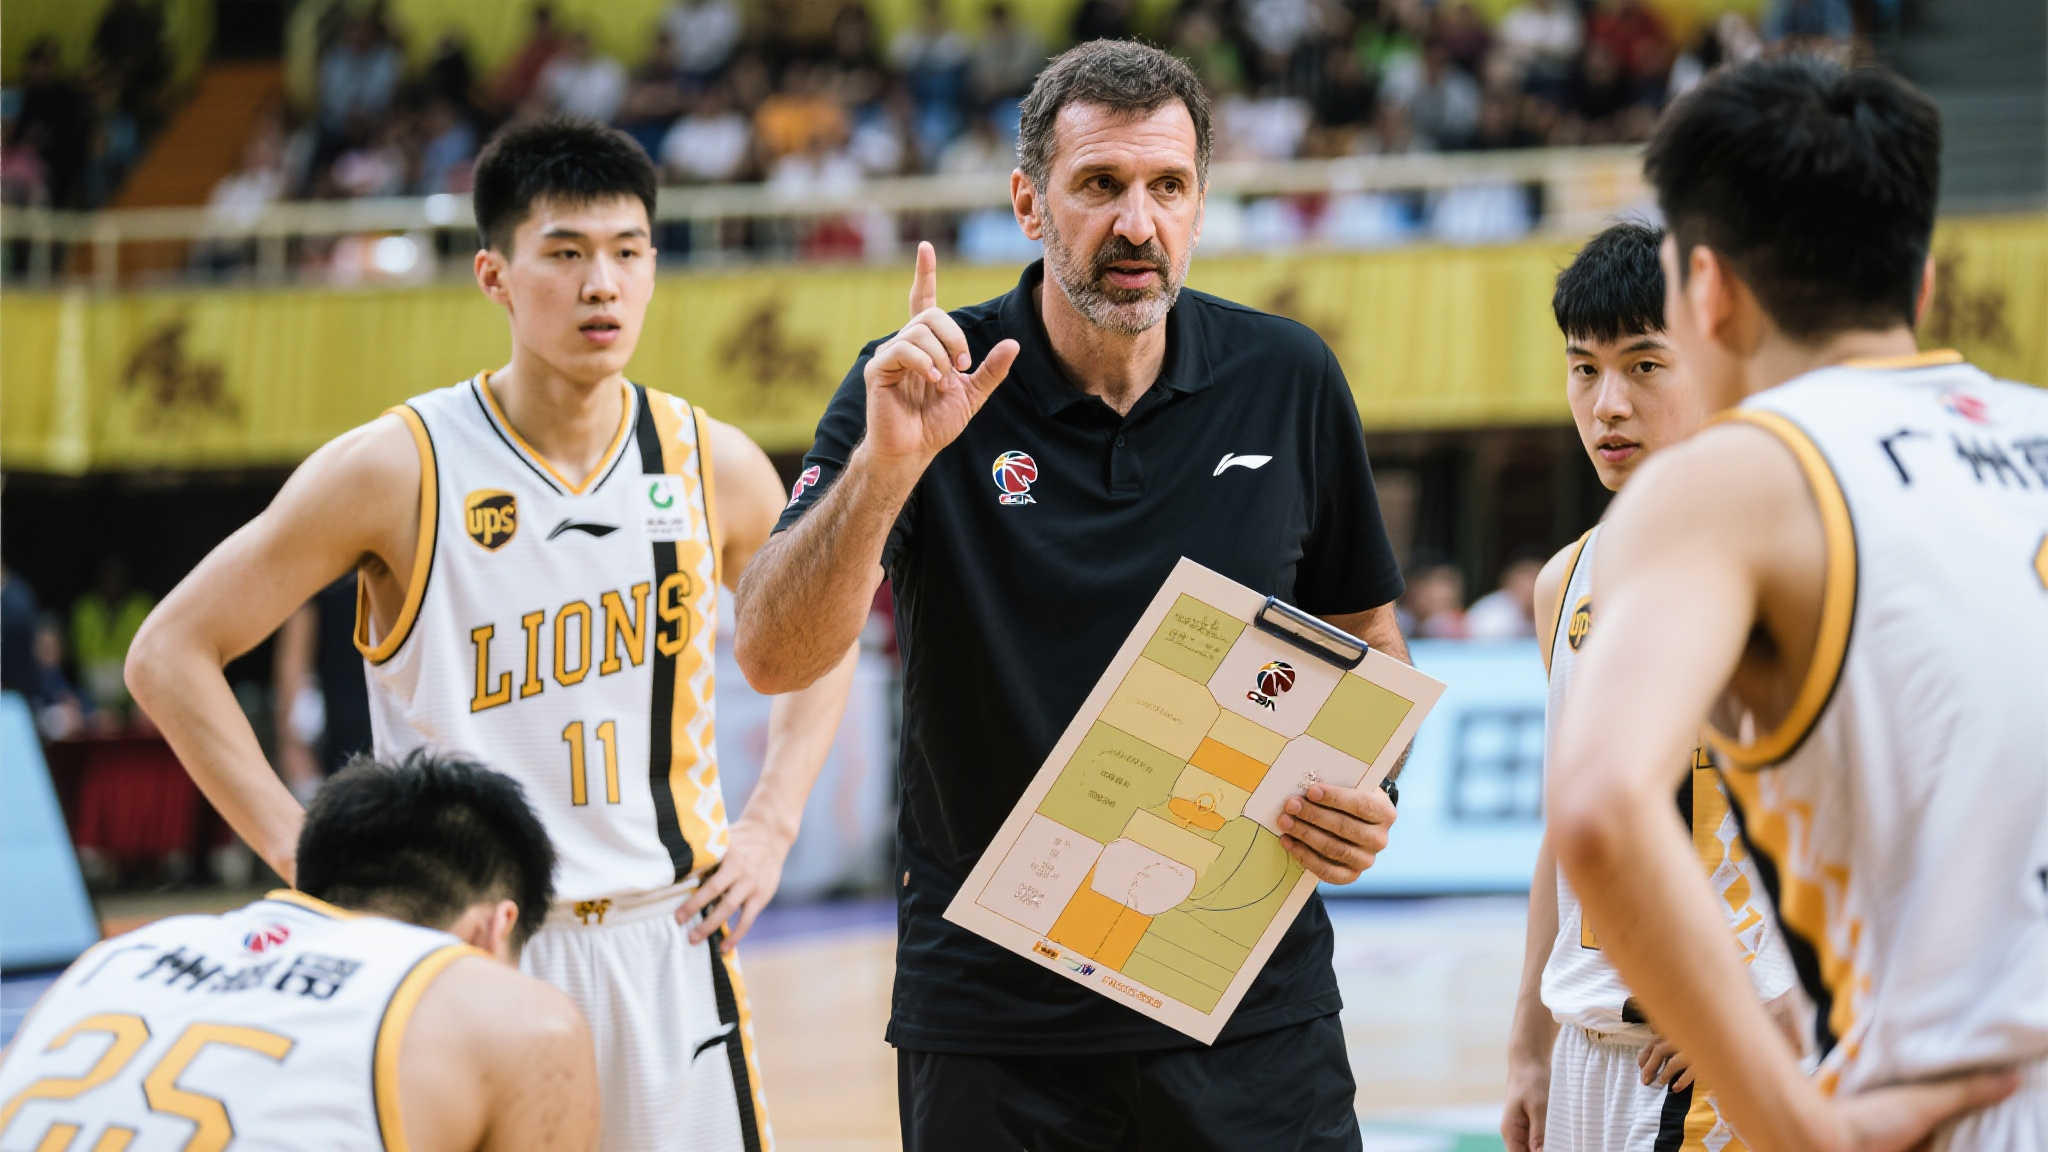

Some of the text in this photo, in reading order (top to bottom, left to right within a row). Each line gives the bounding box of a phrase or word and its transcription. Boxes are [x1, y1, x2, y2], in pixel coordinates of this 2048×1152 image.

[469, 506, 516, 545] ups
[470, 571, 692, 714] LIONS
[562, 720, 621, 806] 11
[0, 1012, 296, 1152] 25
